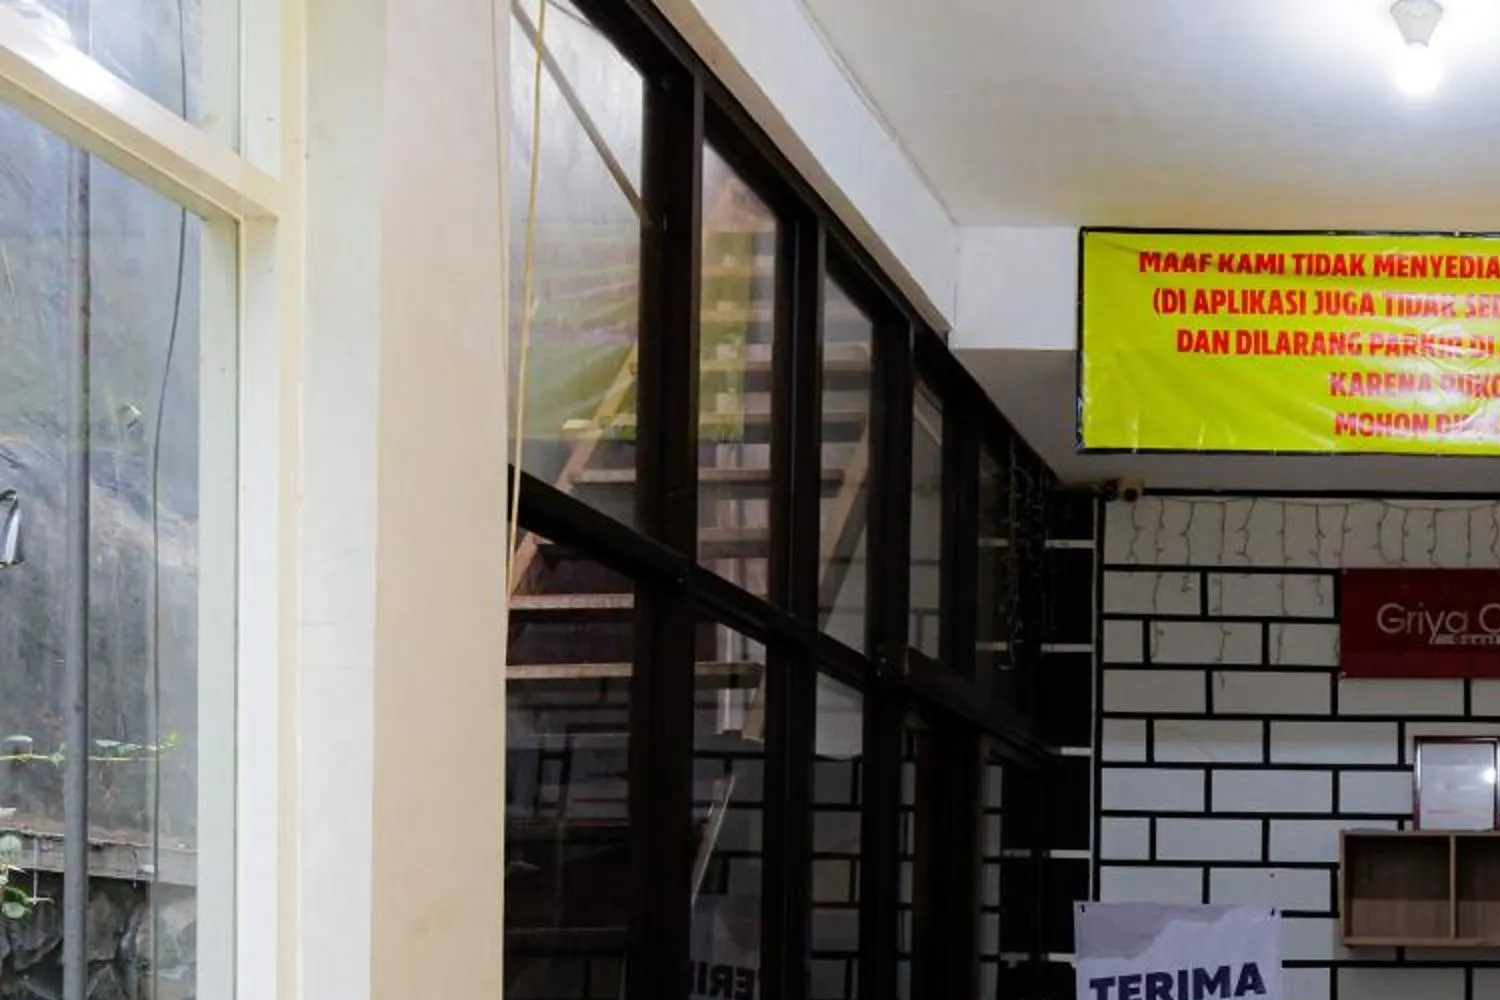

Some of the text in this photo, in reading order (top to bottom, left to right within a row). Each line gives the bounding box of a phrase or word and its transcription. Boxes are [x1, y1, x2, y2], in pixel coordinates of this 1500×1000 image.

[1138, 252, 1213, 273] MAAF
[1217, 252, 1285, 275] KAMI
[1292, 253, 1367, 277] TIDAK
[1152, 288, 1187, 316] (DI
[1193, 289, 1307, 316] APLIKASI
[1312, 290, 1376, 317] JUGA
[1382, 292, 1457, 318] TIDAK
[1176, 329, 1230, 356] DAN
[1235, 330, 1363, 357] DILARANG
[1329, 372, 1433, 398] KARENA
[1334, 413, 1430, 437] MOHON
[1376, 602, 1469, 646] Griya
